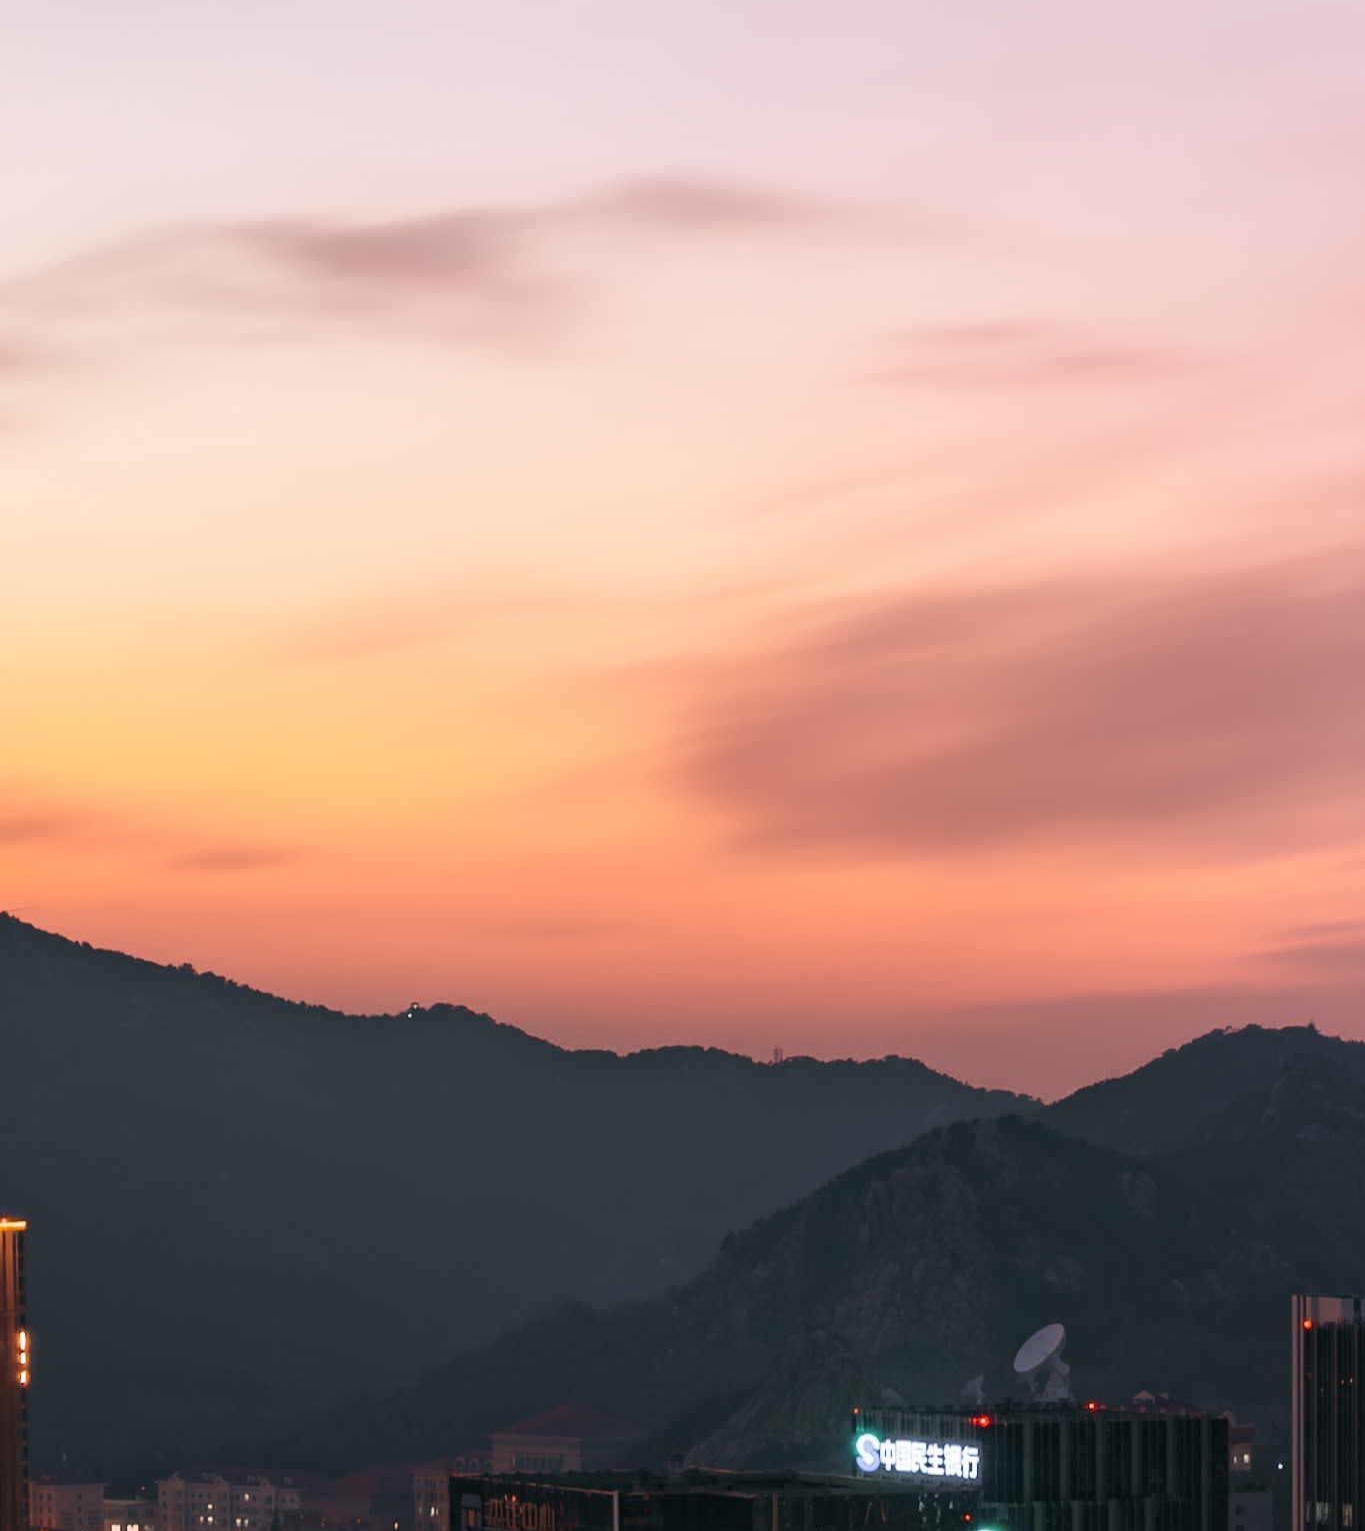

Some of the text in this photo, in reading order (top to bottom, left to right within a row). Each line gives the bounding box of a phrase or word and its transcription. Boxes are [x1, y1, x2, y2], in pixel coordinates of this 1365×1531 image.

[880, 1438, 979, 1479] 中国民生银行
